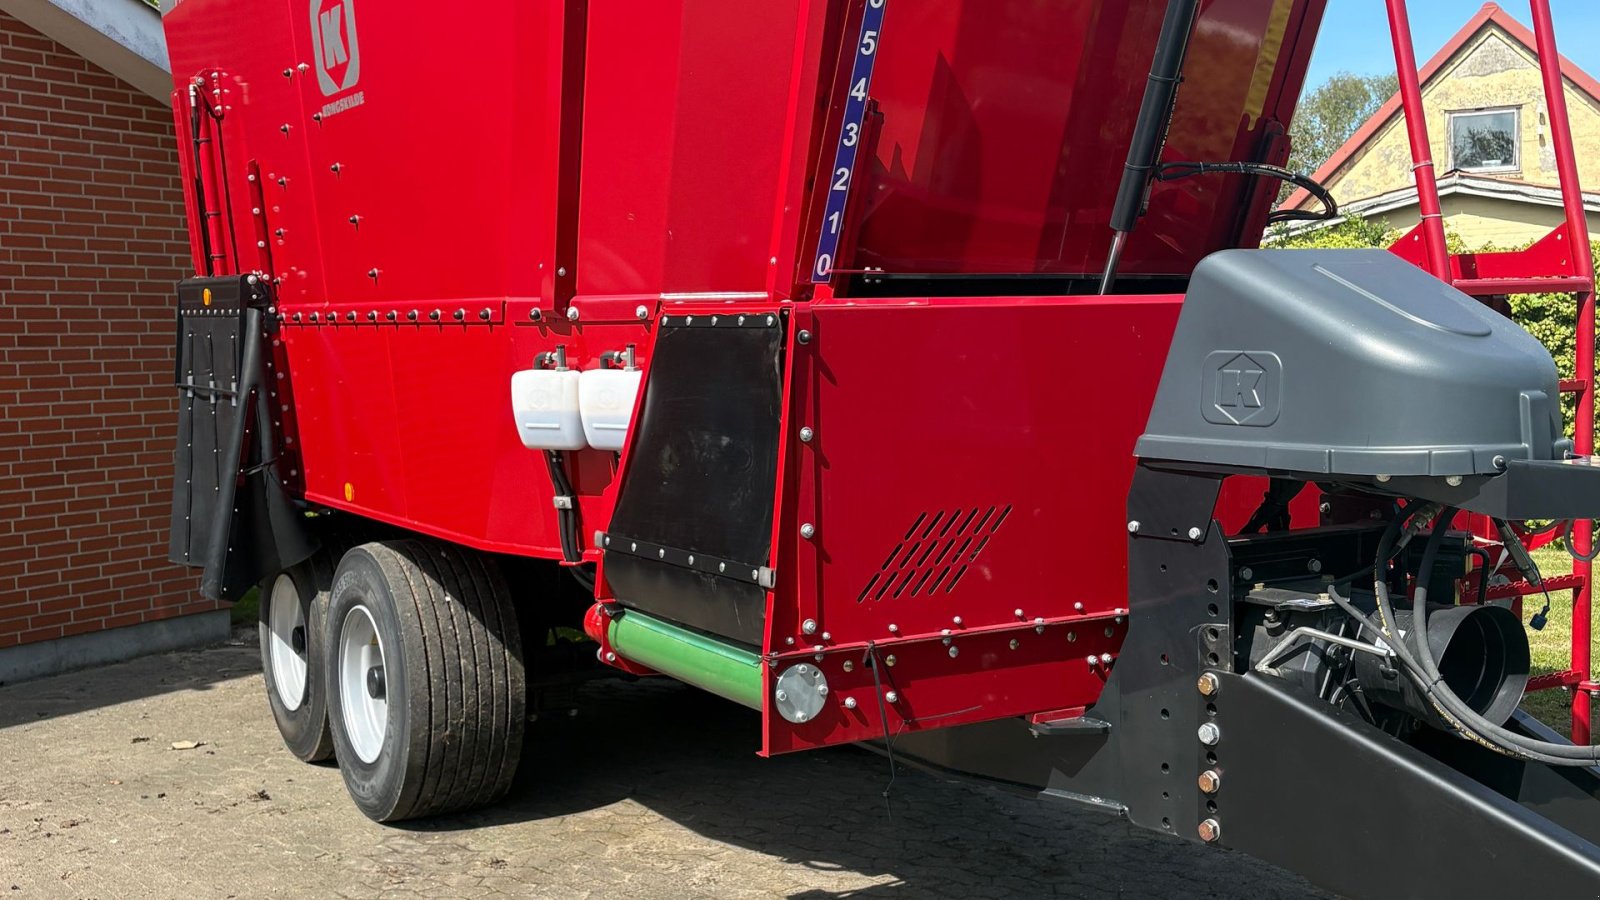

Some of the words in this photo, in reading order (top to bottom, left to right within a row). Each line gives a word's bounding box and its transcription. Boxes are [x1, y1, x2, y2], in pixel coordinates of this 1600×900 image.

[320, 4, 347, 69] K
[860, 30, 877, 56] 5
[850, 77, 867, 102] 4
[842, 122, 859, 147] 3
[832, 167, 850, 191] 2
[828, 211, 840, 234] 1
[816, 253, 832, 276] 0
[1220, 369, 1262, 408] K
